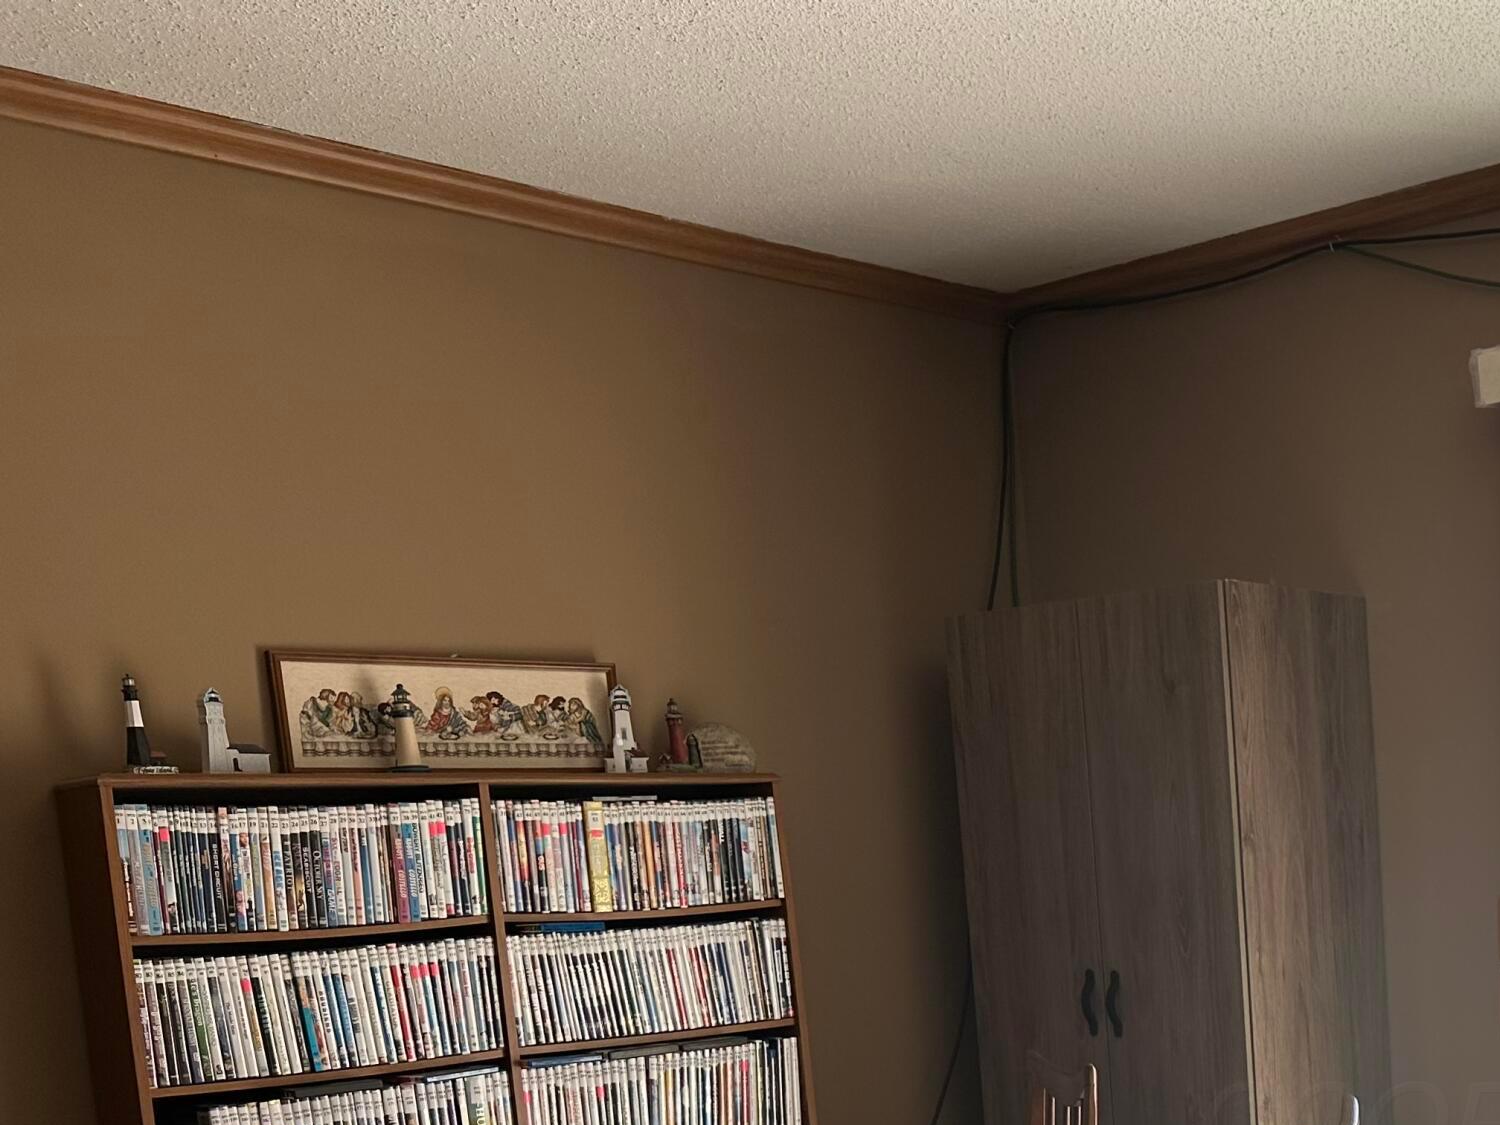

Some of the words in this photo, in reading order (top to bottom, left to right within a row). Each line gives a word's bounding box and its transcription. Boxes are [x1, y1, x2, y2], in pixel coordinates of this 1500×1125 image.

[212, 843, 220, 870] SHORT
[285, 854, 293, 890] PATRIOT
[302, 846, 312, 893] SEABISCUIT
[214, 870, 222, 899] CIRCUIT
